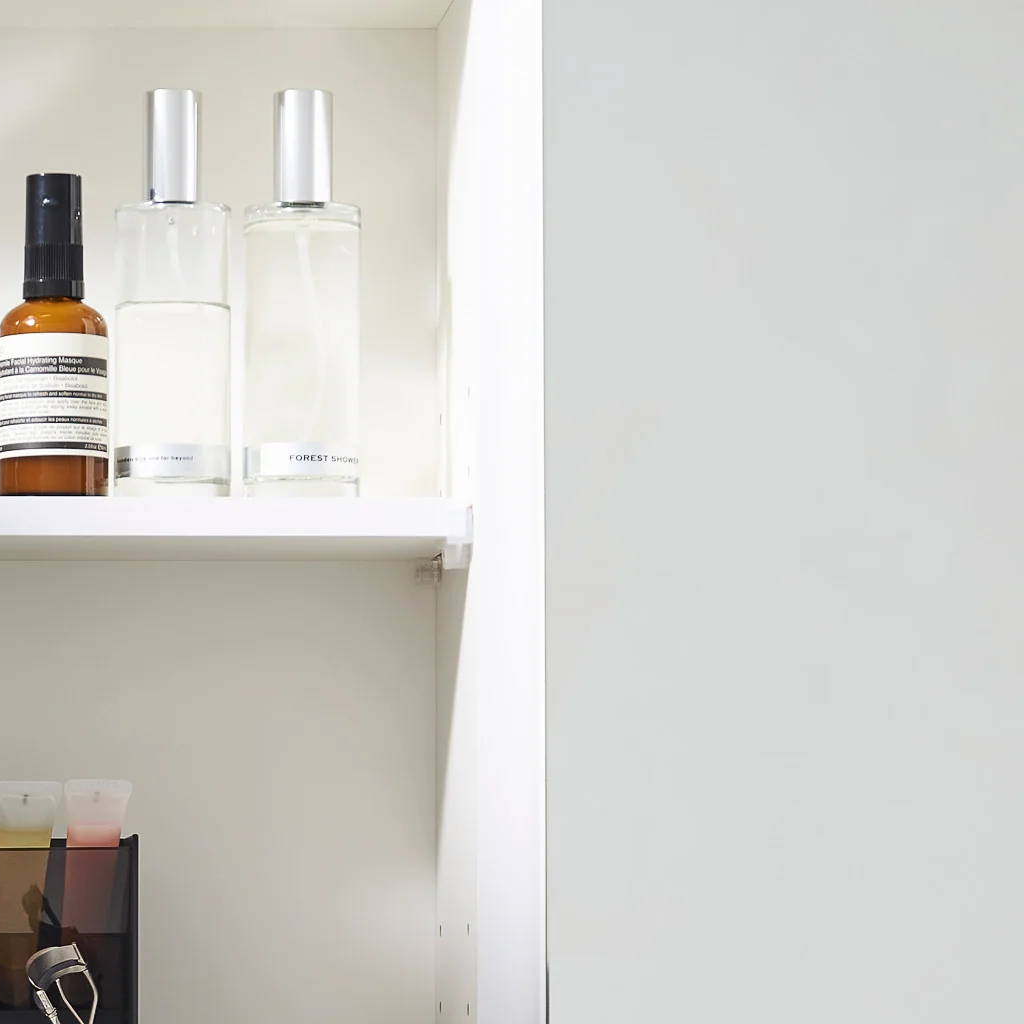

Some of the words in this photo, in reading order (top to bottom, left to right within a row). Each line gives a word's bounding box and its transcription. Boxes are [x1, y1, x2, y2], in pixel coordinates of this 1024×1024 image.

[27, 356, 57, 366] Hydrating
[58, 356, 83, 365] Masque
[58, 365, 77, 373] Bleue
[290, 454, 328, 462] FOREST
